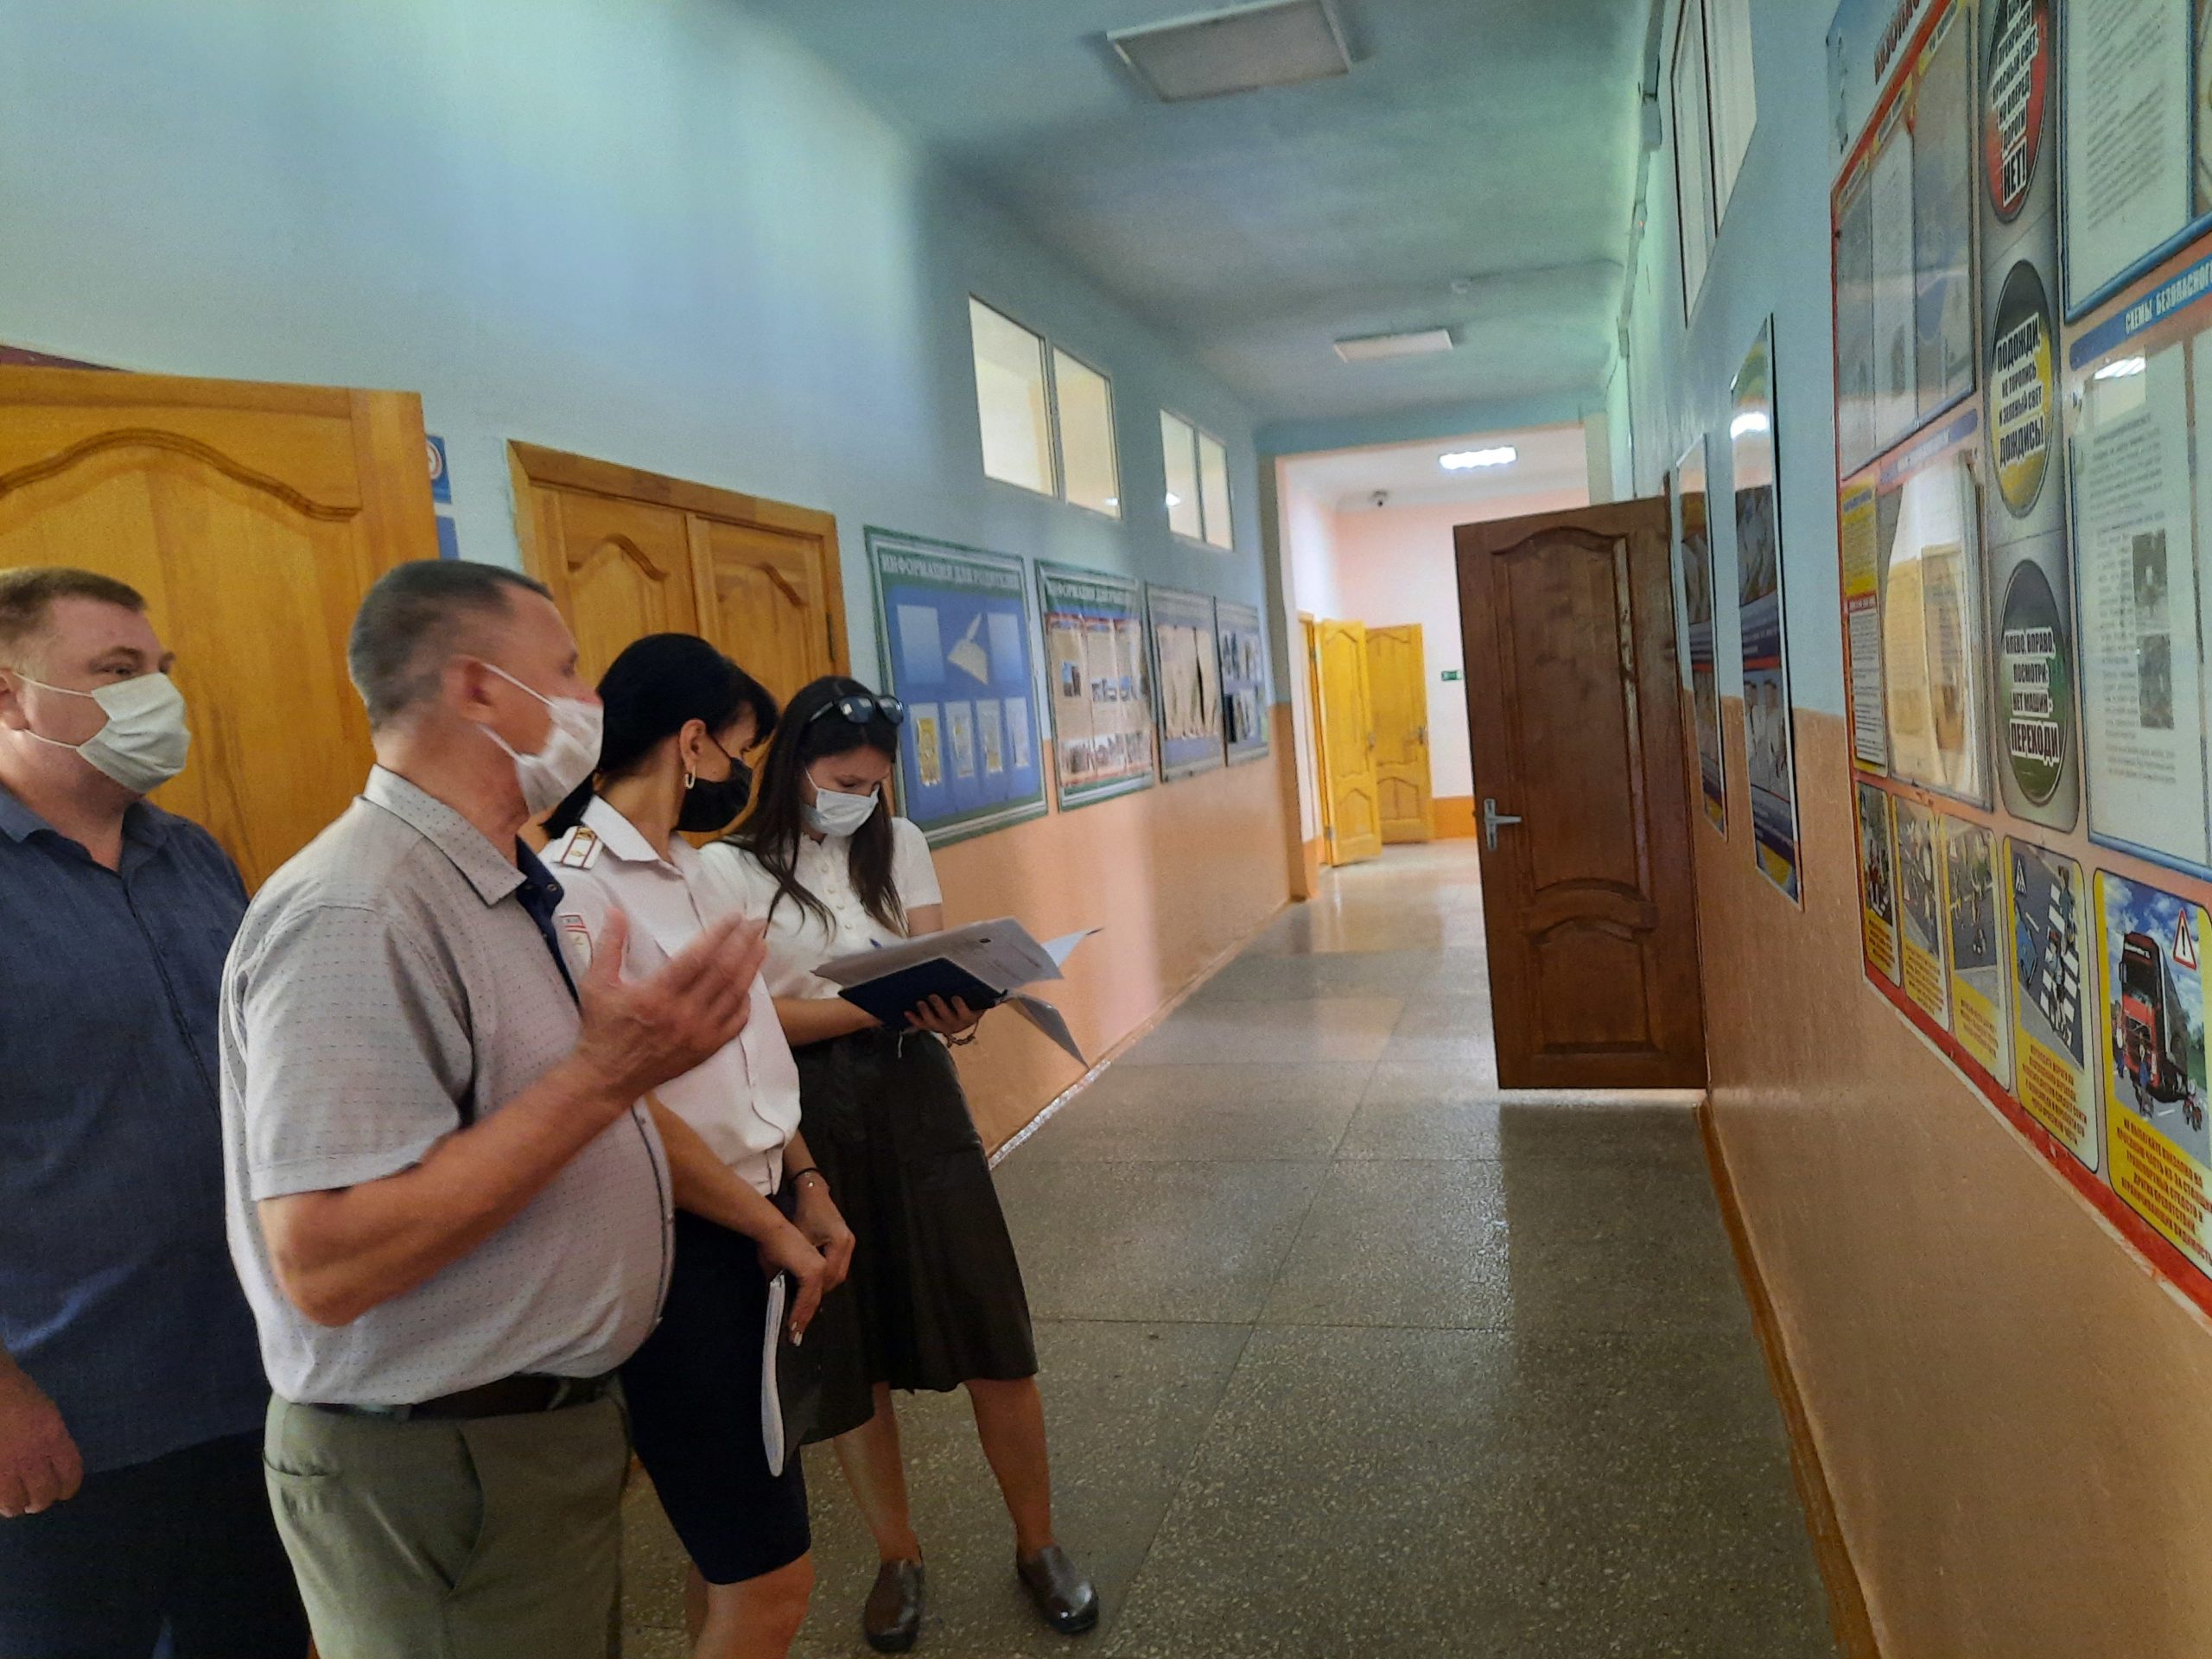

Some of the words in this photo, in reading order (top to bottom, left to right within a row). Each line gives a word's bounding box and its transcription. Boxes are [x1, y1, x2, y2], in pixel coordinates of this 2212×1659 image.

[2004, 140, 2025, 203] НЕТ!
[1999, 416, 2044, 467] ДОЖДИСЬ!
[2012, 692, 2023, 711] НЕТ
[2011, 722, 2060, 761] ПЕРЕХОДИ
